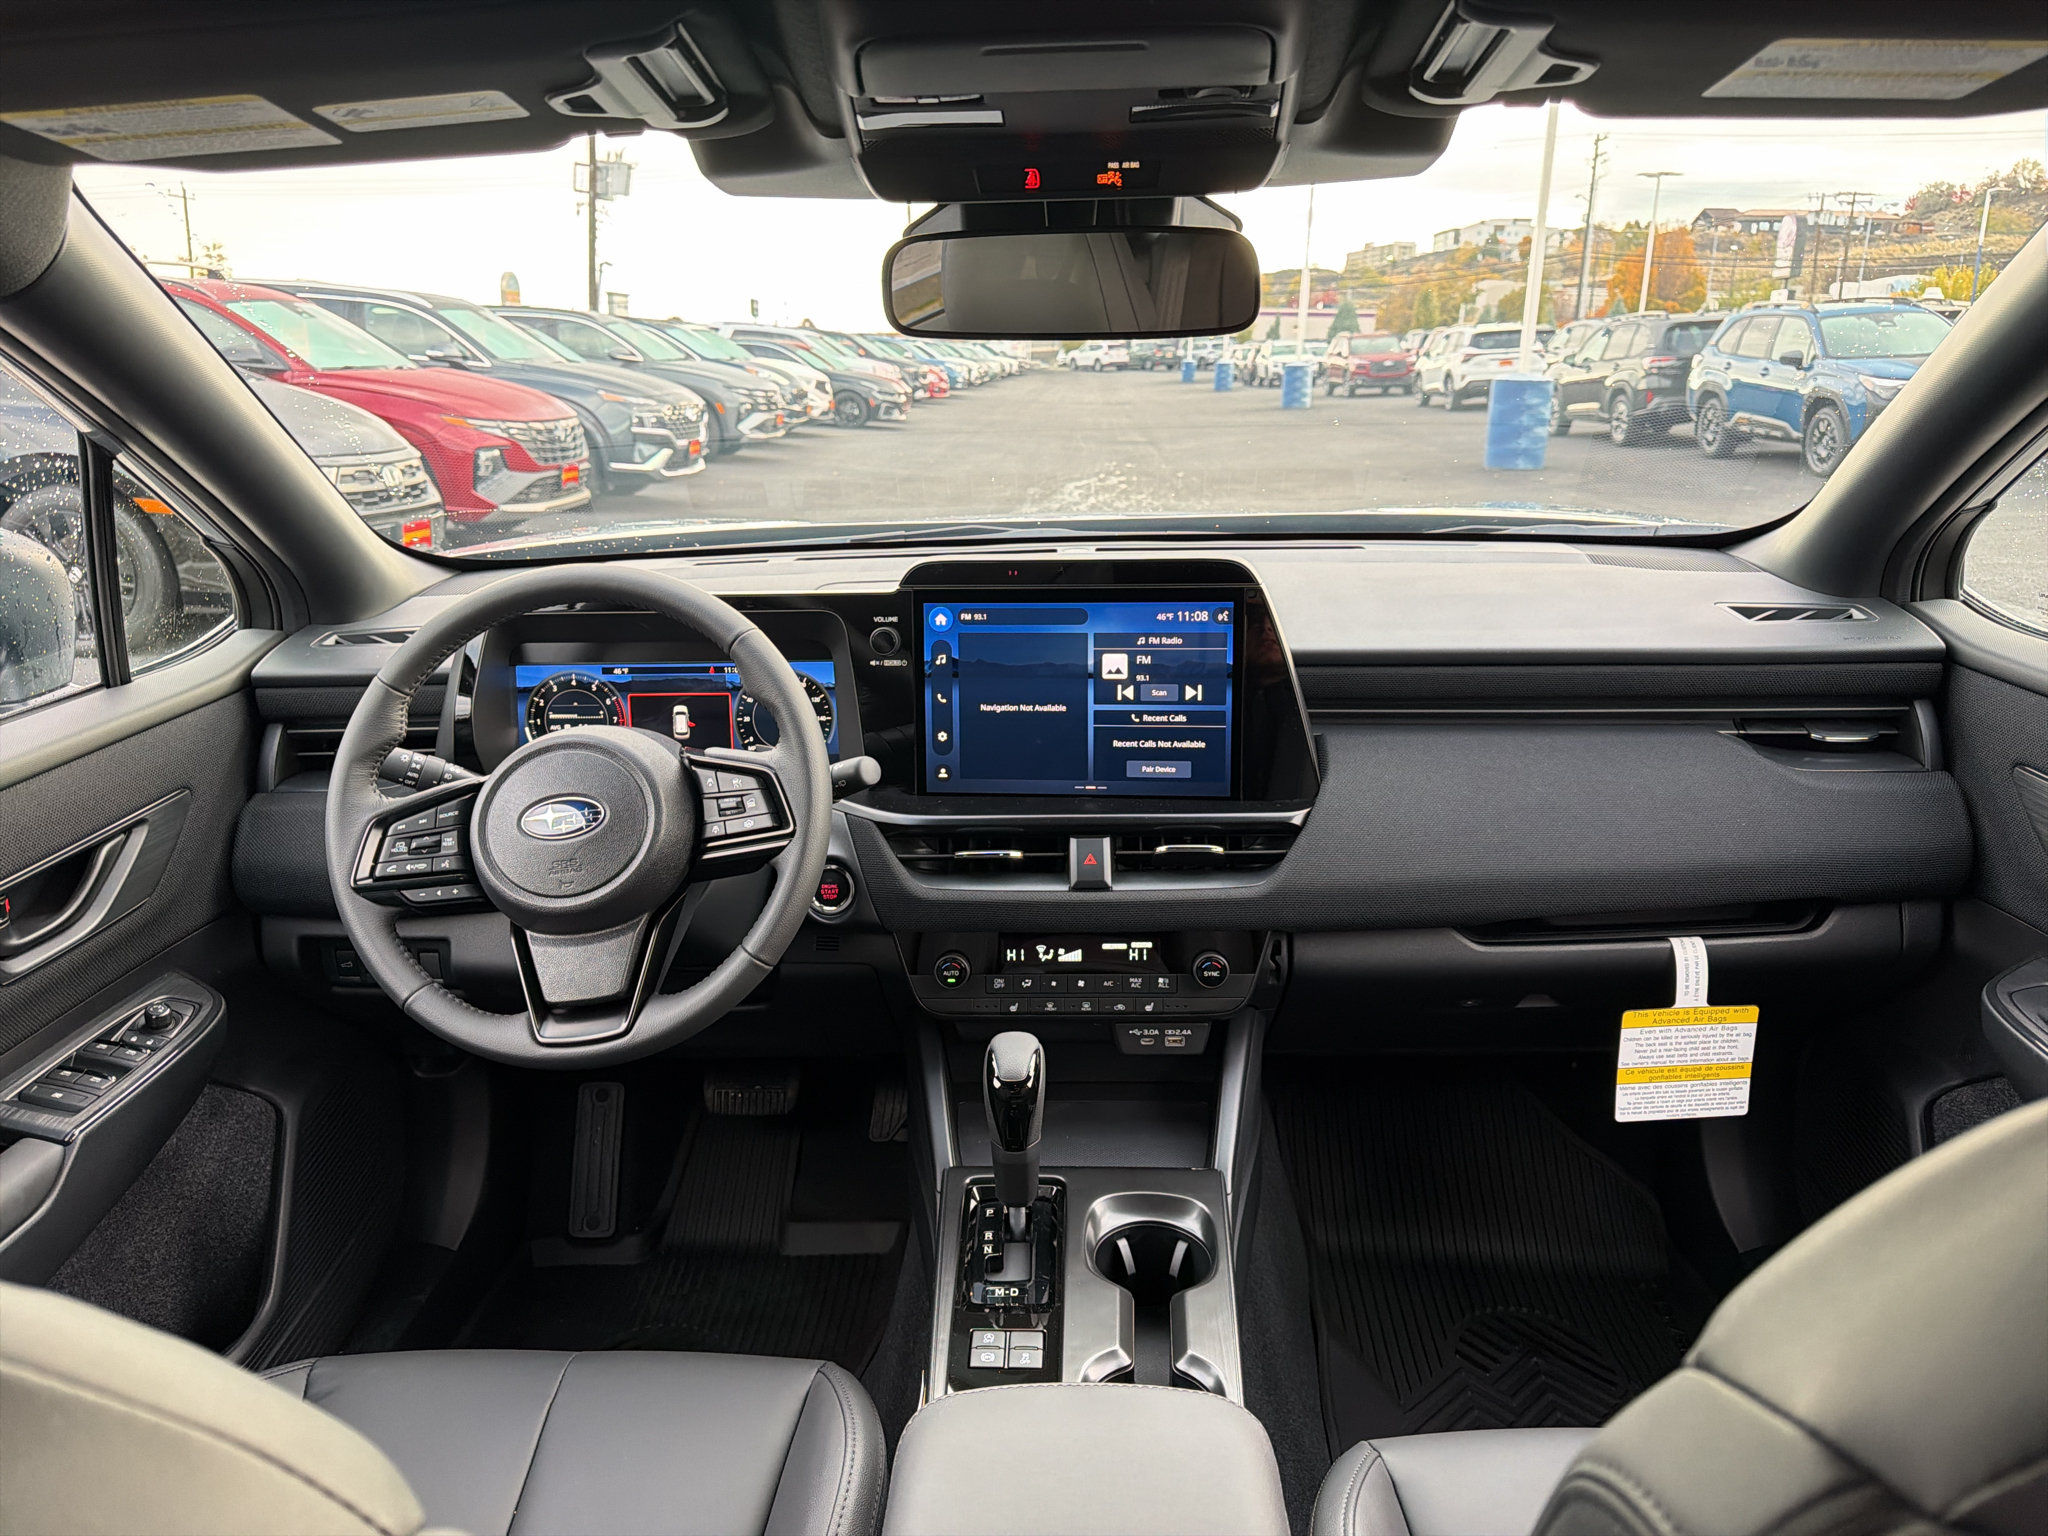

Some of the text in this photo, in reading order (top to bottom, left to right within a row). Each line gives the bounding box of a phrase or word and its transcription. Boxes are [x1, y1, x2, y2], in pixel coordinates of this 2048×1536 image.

[973, 613, 987, 621] 93.1
[1177, 610, 1209, 622] 11:08
[1148, 636, 1183, 645] FM Radio
[1136, 655, 1152, 665] FM
[1136, 674, 1150, 682] 93.1
[1151, 689, 1168, 697] Scan
[980, 703, 1067, 714] Navigation Not Available
[1142, 714, 1187, 722] Recent Calls
[1113, 740, 1206, 749] Recent Calls Not Available
[551, 859, 580, 869] SRS
[549, 866, 582, 877] AIRBAG
[1006, 948, 1025, 961] HI
[1129, 948, 1147, 961] HI
[1693, 1007, 1730, 1016] Equipped
[1652, 1017, 1690, 1025] Advanced
[1707, 1015, 1728, 1024] Bags
[1721, 1025, 1738, 1033] Bags
[1648, 1072, 1721, 1082] gonflables intelligents
[986, 1208, 995, 1217] P
[984, 1232, 994, 1241] R
[983, 1245, 993, 1254] N
